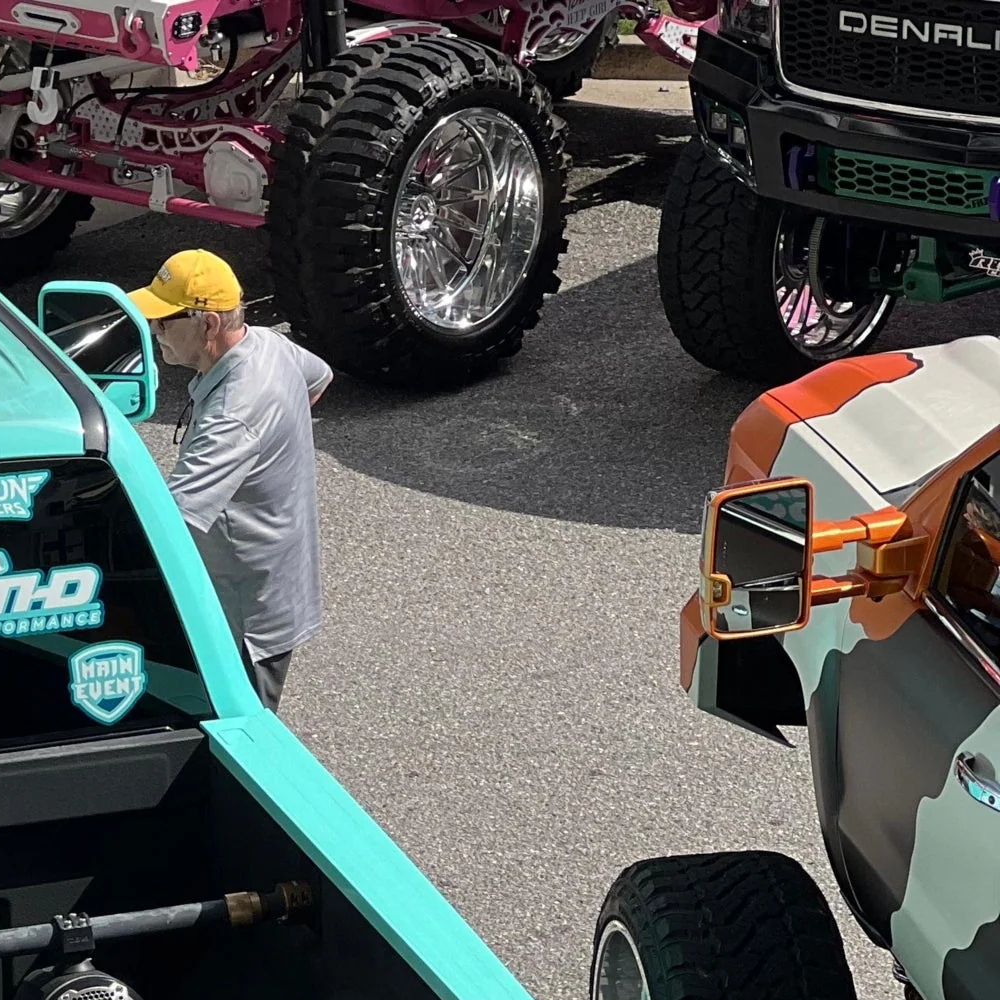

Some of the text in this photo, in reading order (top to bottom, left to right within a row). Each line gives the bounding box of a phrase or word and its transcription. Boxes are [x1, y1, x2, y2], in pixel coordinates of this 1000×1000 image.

[839, 10, 1000, 51] DENALI
[81, 656, 133, 681] MAIN
[75, 676, 142, 701] EVENT
